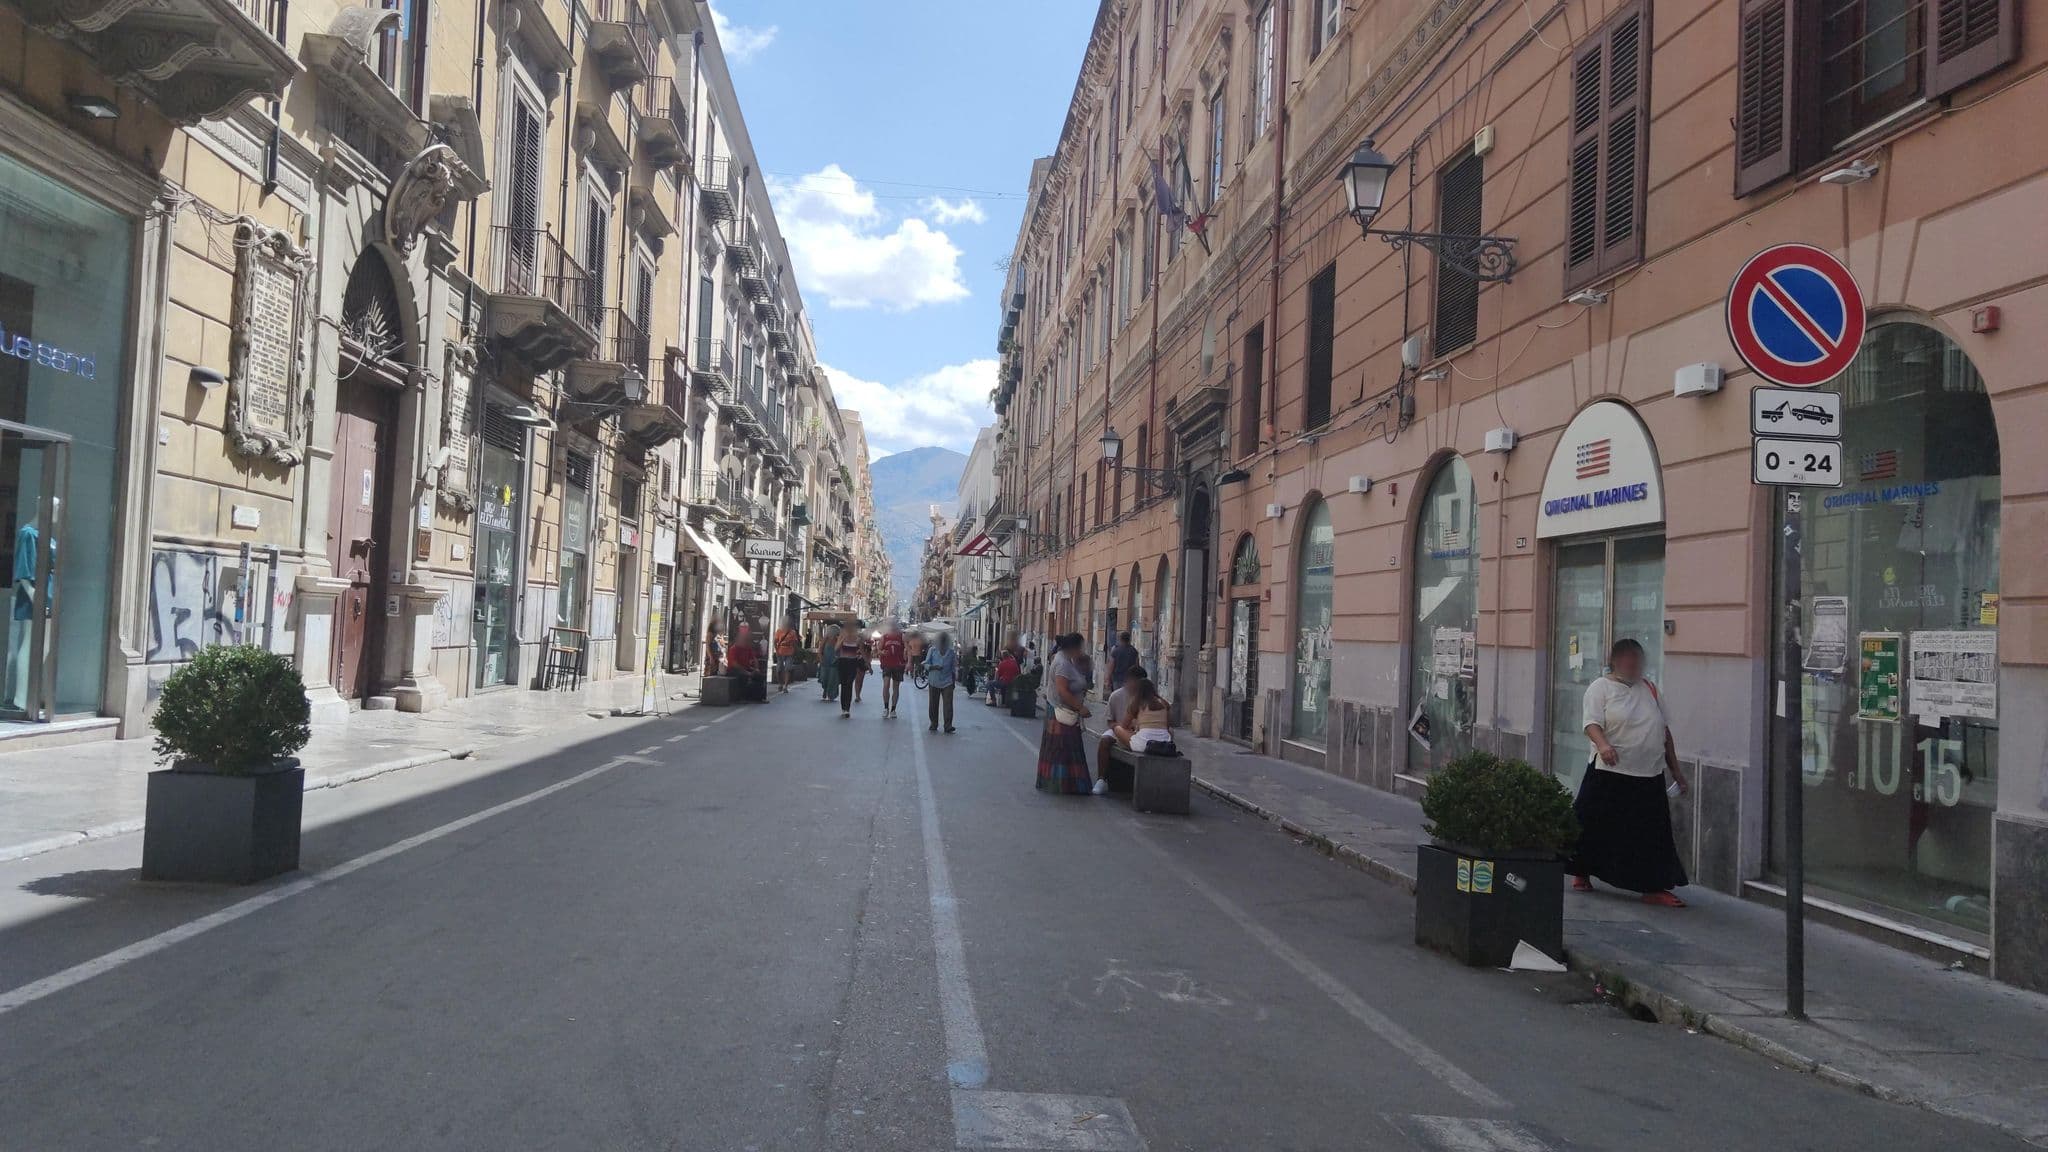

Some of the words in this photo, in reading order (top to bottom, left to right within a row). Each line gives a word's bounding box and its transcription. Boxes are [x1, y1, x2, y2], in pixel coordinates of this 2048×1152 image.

[0, 321, 32, 360] ue
[37, 343, 97, 380] sand
[1765, 452, 1780, 470] 0
[1803, 453, 1832, 472] 24
[1544, 493, 1594, 516] ORIGINAL
[1594, 482, 1649, 507] MARINES
[1823, 490, 1878, 509] ORIGINAL
[1881, 481, 1940, 503] MARINES
